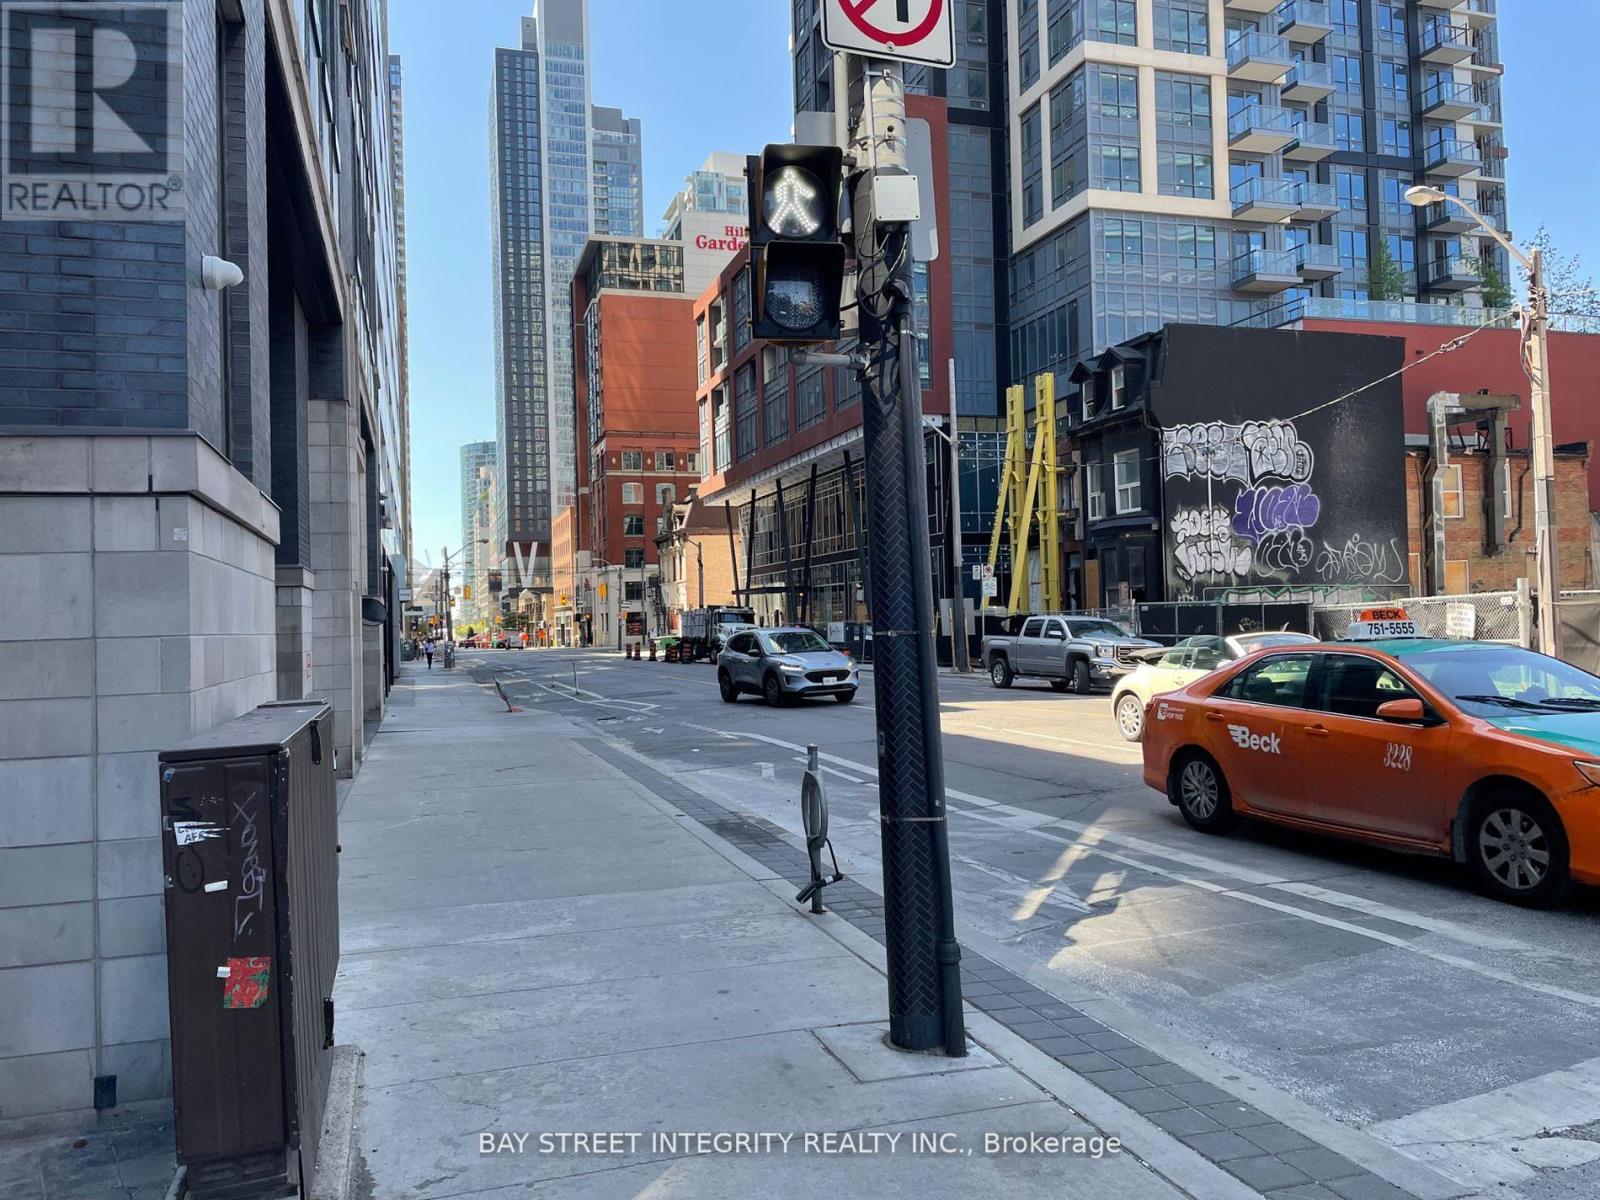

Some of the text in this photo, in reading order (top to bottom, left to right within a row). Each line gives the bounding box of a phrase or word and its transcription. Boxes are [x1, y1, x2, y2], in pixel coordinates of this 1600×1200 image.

[724, 225, 745, 238] Hil
[695, 234, 747, 251] Garde
[1372, 609, 1402, 620] BECK
[1367, 622, 1415, 635] 751-5555
[1227, 724, 1281, 755] Beck
[1383, 742, 1413, 772] 3228
